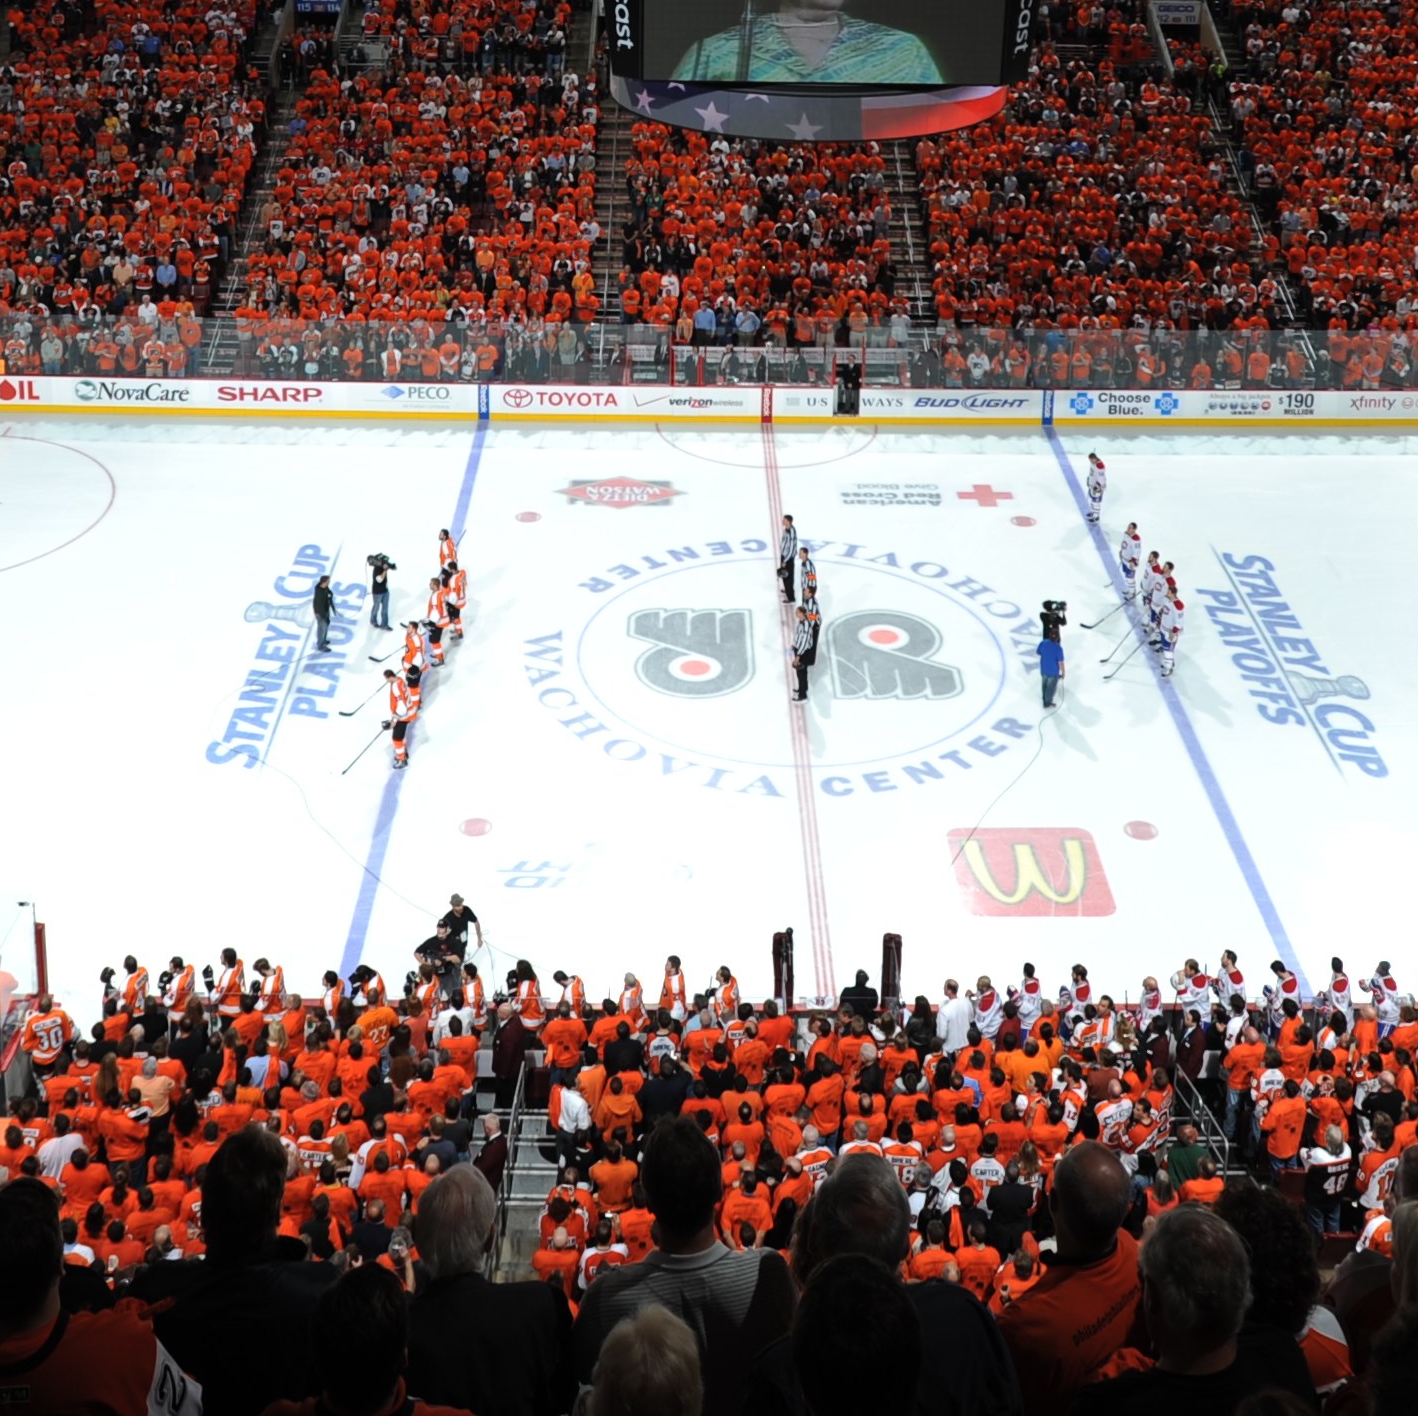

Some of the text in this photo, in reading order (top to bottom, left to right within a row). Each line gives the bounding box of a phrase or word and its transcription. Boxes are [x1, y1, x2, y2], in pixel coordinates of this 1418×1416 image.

[297, 3, 341, 12] 115 114
[1158, 5, 1195, 13] GEICO
[1185, 15, 1197, 23] 111
[97, 382, 190, 402] NovaCare
[217, 386, 323, 402] SHARP
[408, 387, 450, 400] PECO
[536, 392, 618, 406] TOYOTA
[1098, 392, 1151, 404] Choose
[668, 397, 743, 408] verizon wireless
[914, 396, 1029, 409] BUD LIGHT
[1278, 393, 1315, 409] $190
[1350, 395, 1397, 410] xfinity
[840, 491, 941, 499] Red Cross
[841, 498, 941, 506] American
[577, 538, 768, 595] CENTER
[205, 543, 331, 770] STANLEY CUP
[1195, 588, 1306, 727] PLAYOFFS
[1222, 552, 1390, 778] STANLEY CUP
[522, 629, 1036, 799] WACHOVIA CENTER
[37, 1026, 63, 1051] 30
[369, 1024, 388, 1044] 27
[302, 1151, 327, 1161] CARTER
[974, 1168, 1000, 1177] CARTER
[1322, 1173, 1348, 1195] 48
